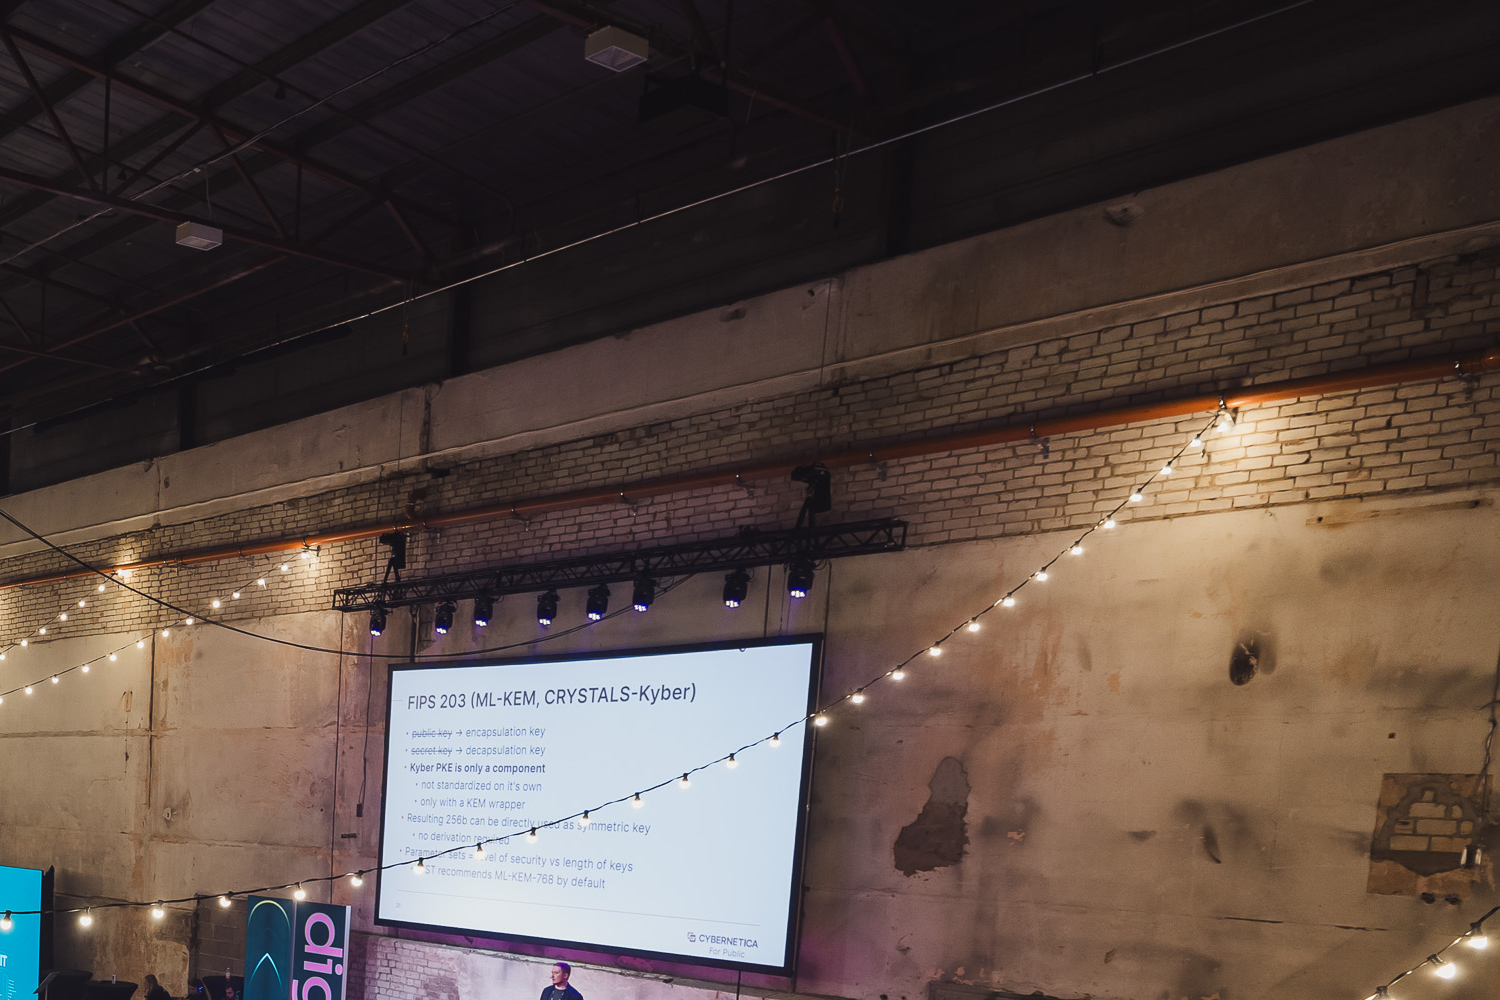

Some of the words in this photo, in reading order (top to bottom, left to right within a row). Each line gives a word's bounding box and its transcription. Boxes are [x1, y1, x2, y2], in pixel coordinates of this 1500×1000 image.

[407, 695, 436, 710] FIPS
[440, 693, 466, 709] 203
[471, 690, 540, 709] (ML-KEM,
[544, 683, 697, 705] CRYSTALS-Kyber)
[465, 727, 528, 739] encapsulation
[529, 726, 546, 738] key
[465, 745, 528, 757] decapsulation
[529, 745, 546, 757] key
[409, 762, 435, 774] Kyber
[435, 763, 453, 773] PKE
[454, 763, 462, 773] is
[464, 763, 483, 775] only
[485, 765, 491, 774] a
[492, 764, 546, 776] component
[421, 781, 435, 790] not
[436, 780, 492, 791] standardized
[493, 783, 505, 791] on
[507, 781, 521, 791] it's
[522, 783, 542, 792] own
[420, 797, 437, 808] only
[439, 797, 457, 807] with
[459, 800, 465, 808] a
[466, 798, 486, 808] KEM
[488, 800, 526, 811] wrapper
[407, 813, 444, 826] Resulting
[446, 814, 467, 825] 256b
[469, 817, 485, 826] can
[487, 816, 499, 827] be
[501, 817, 535, 829] directly
[563, 821, 575, 830] as
[632, 822, 651, 836] key
[418, 832, 428, 841] no
[430, 832, 472, 843] derivation
[448, 849, 466, 860] sets
[499, 852, 509, 863] of
[510, 854, 547, 868] security
[549, 858, 560, 867] vs
[562, 857, 594, 871] length
[596, 859, 608, 870] of
[609, 860, 633, 874] keys
[437, 866, 493, 879] recommends
[494, 870, 554, 885] ML-KEM-768
[556, 875, 569, 888] by
[571, 876, 606, 889] default
[698, 934, 758, 948] CYBERNETICA
[708, 947, 720, 955] For
[722, 948, 746, 958] Public
